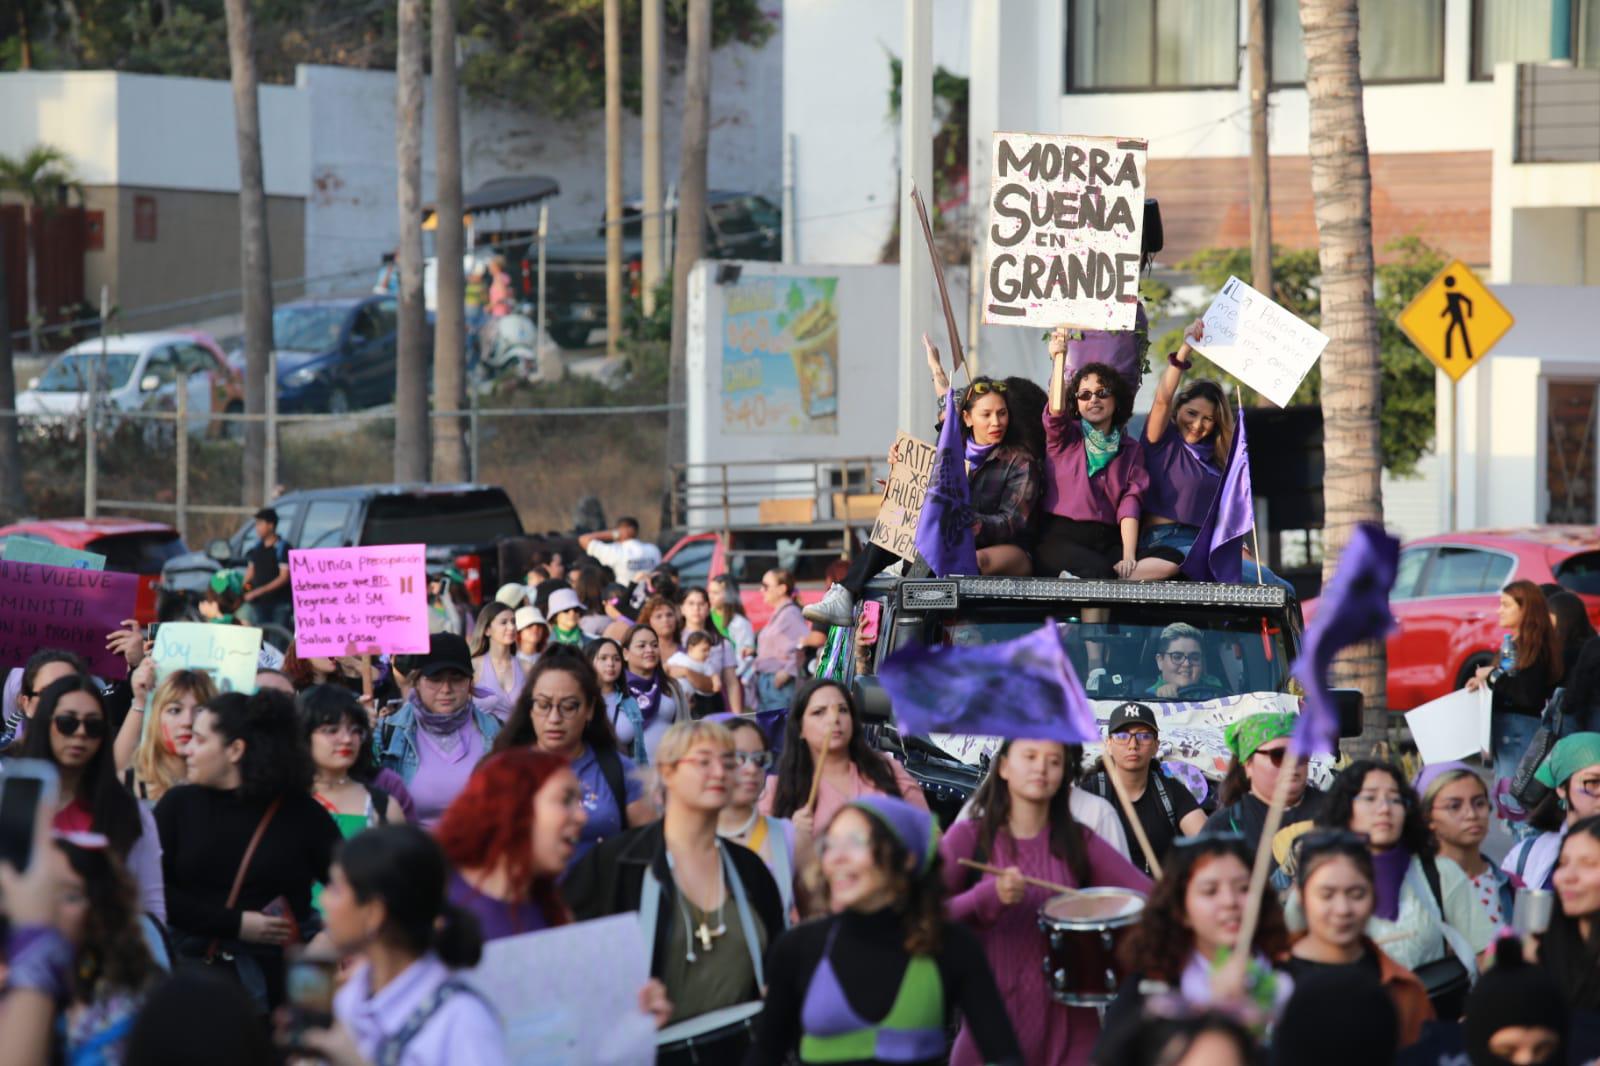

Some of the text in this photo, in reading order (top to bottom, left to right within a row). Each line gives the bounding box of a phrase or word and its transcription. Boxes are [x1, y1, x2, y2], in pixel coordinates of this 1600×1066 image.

[998, 139, 1140, 188] MORRA
[991, 183, 1135, 247] SUEÑA
[1035, 232, 1065, 248] EN
[990, 247, 1139, 303] GRANDE
[872, 519, 891, 544] NOS
[12, 563, 34, 584] SE
[42, 567, 113, 588] VUELVE
[332, 581, 348, 589] ser
[352, 578, 368, 587] que
[296, 595, 338, 612] regrese
[344, 592, 360, 604] del
[320, 613, 331, 625] la
[335, 612, 347, 625] de
[208, 634, 225, 660] la
[337, 634, 345, 643] a
